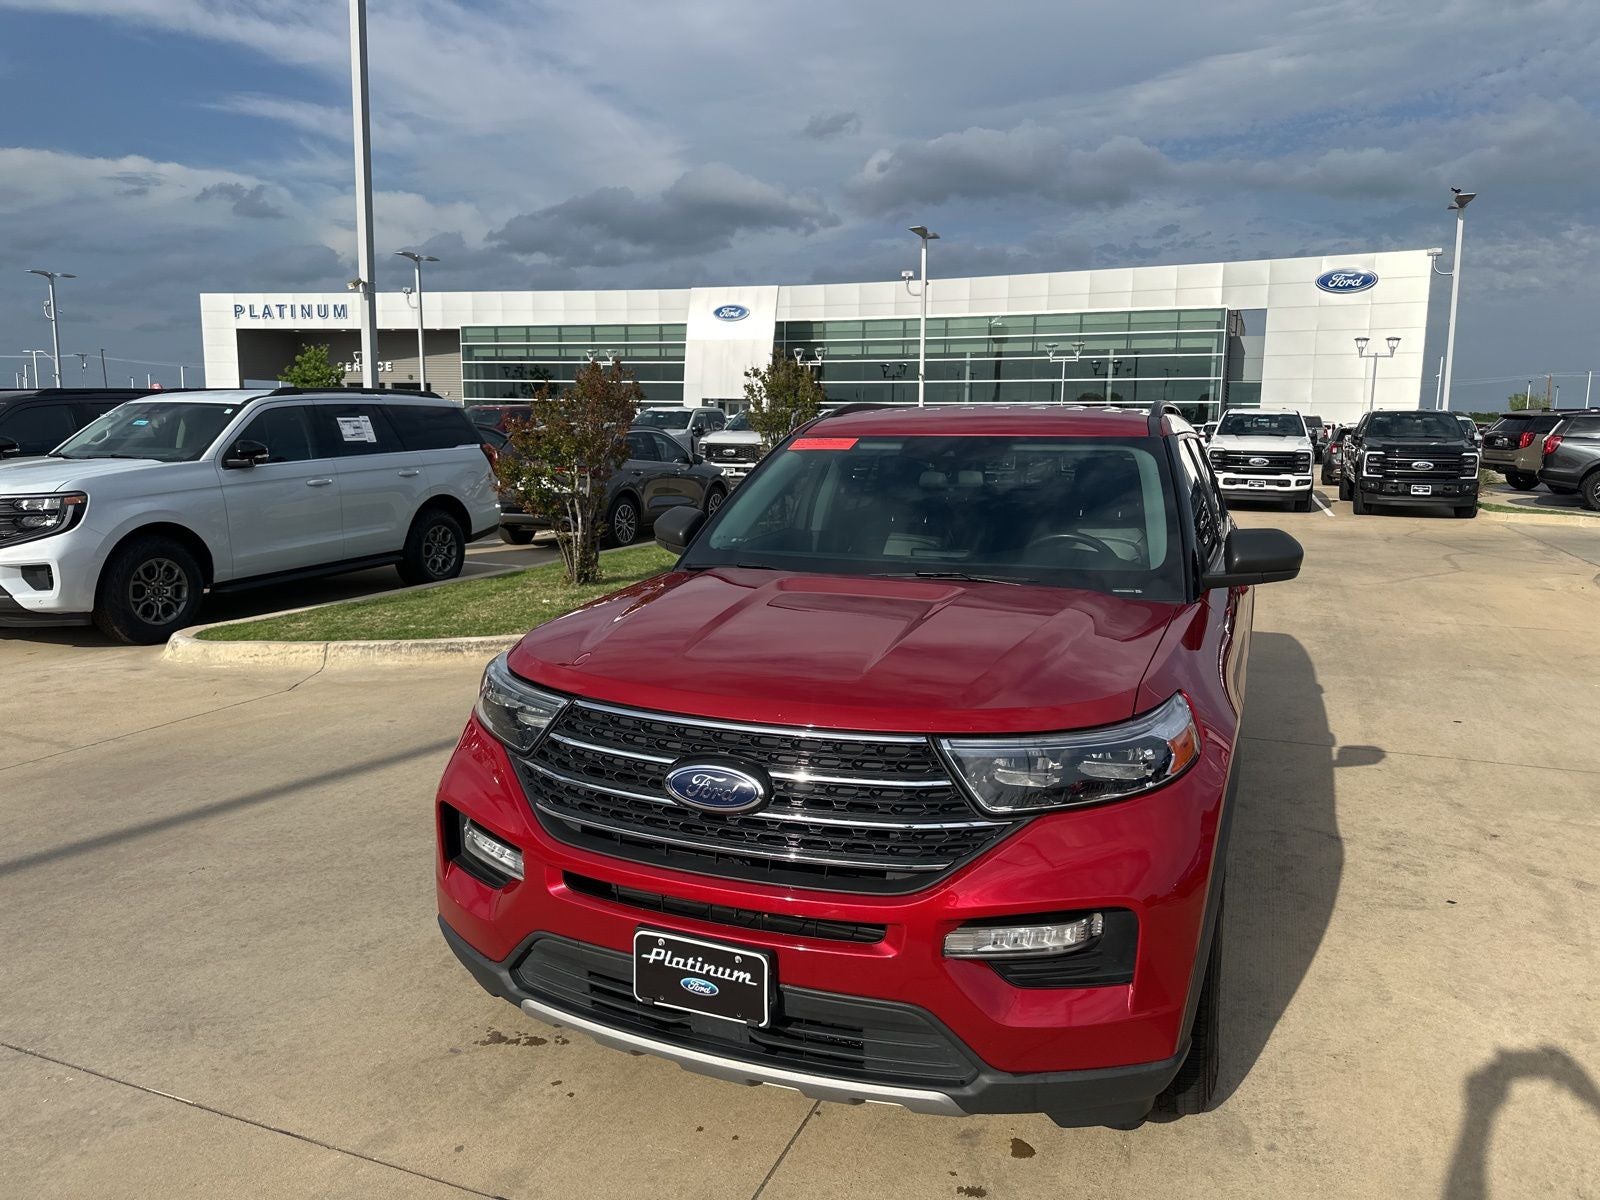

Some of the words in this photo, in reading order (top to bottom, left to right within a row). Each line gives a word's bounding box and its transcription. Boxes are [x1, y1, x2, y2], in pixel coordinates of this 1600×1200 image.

[1328, 273, 1363, 288] Ford
[233, 303, 349, 320] PLATINUM
[337, 361, 393, 372] SERCE
[685, 773, 741, 802] Ford
[641, 947, 758, 986] Platinum
[687, 979, 712, 994] Ford
